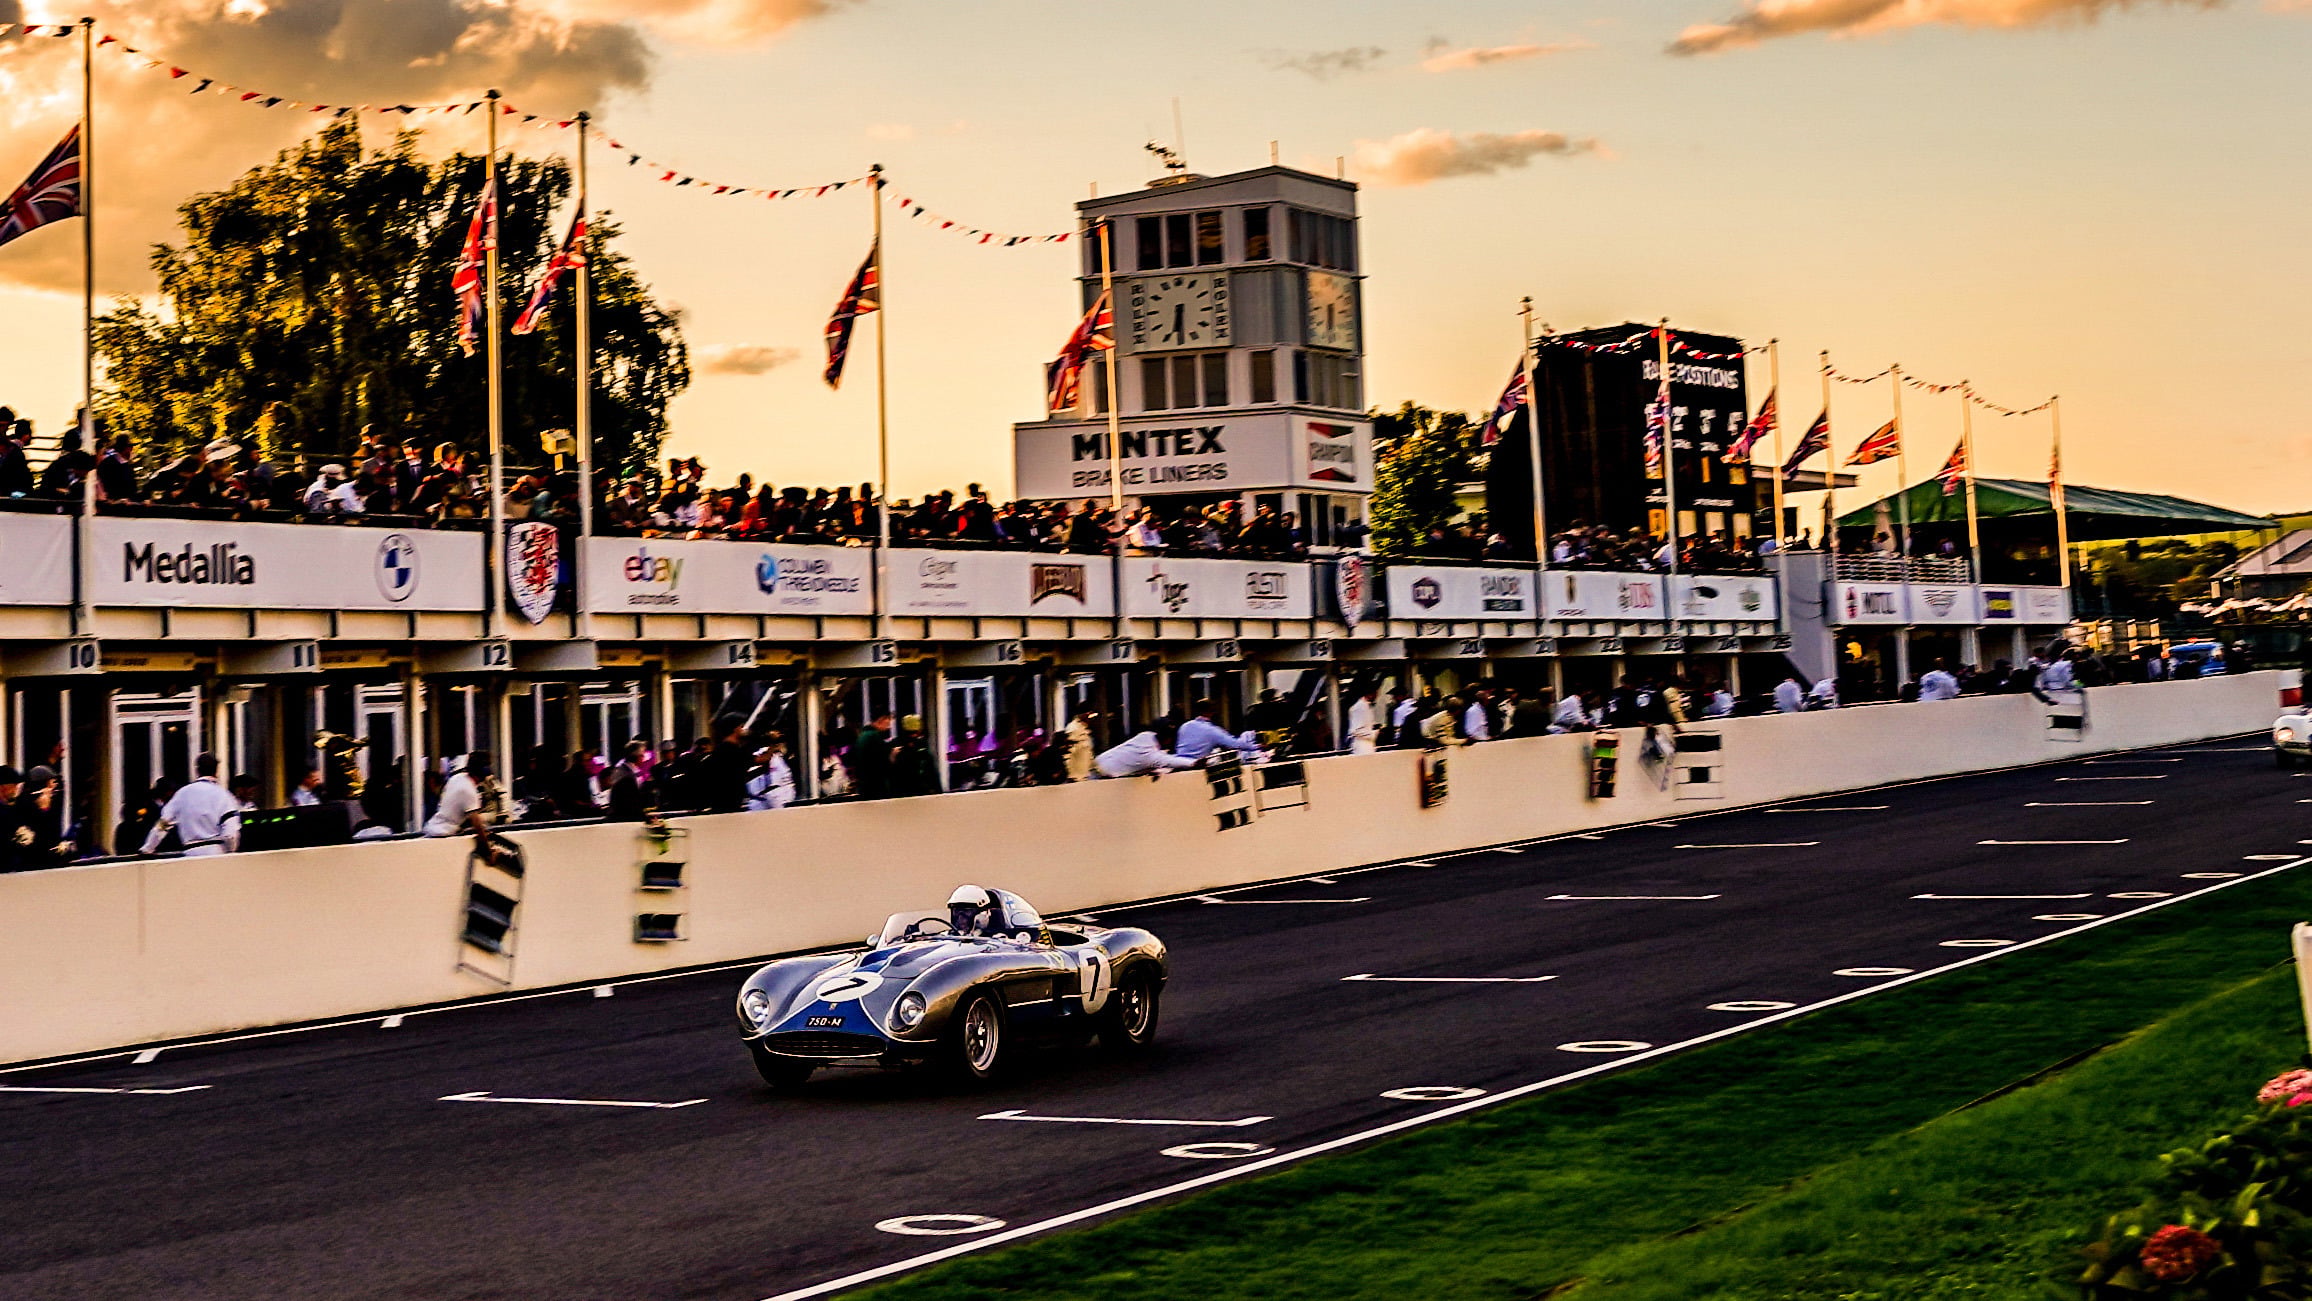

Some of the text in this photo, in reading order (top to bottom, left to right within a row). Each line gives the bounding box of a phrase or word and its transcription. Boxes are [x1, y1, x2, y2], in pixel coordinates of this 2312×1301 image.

[1071, 425, 1226, 461] MINTEX
[1072, 462, 1228, 488] BRAKE LINERS
[124, 541, 255, 584] Medallia
[624, 547, 684, 596] ebay
[70, 644, 95, 668] 10
[294, 644, 315, 667] 11
[483, 644, 508, 666] 12
[729, 643, 753, 664] 14
[871, 642, 895, 662] 15
[998, 642, 1022, 661] 16
[1111, 641, 1131, 658] 17
[820, 977, 868, 996] 7
[1086, 956, 1100, 1001] 7
